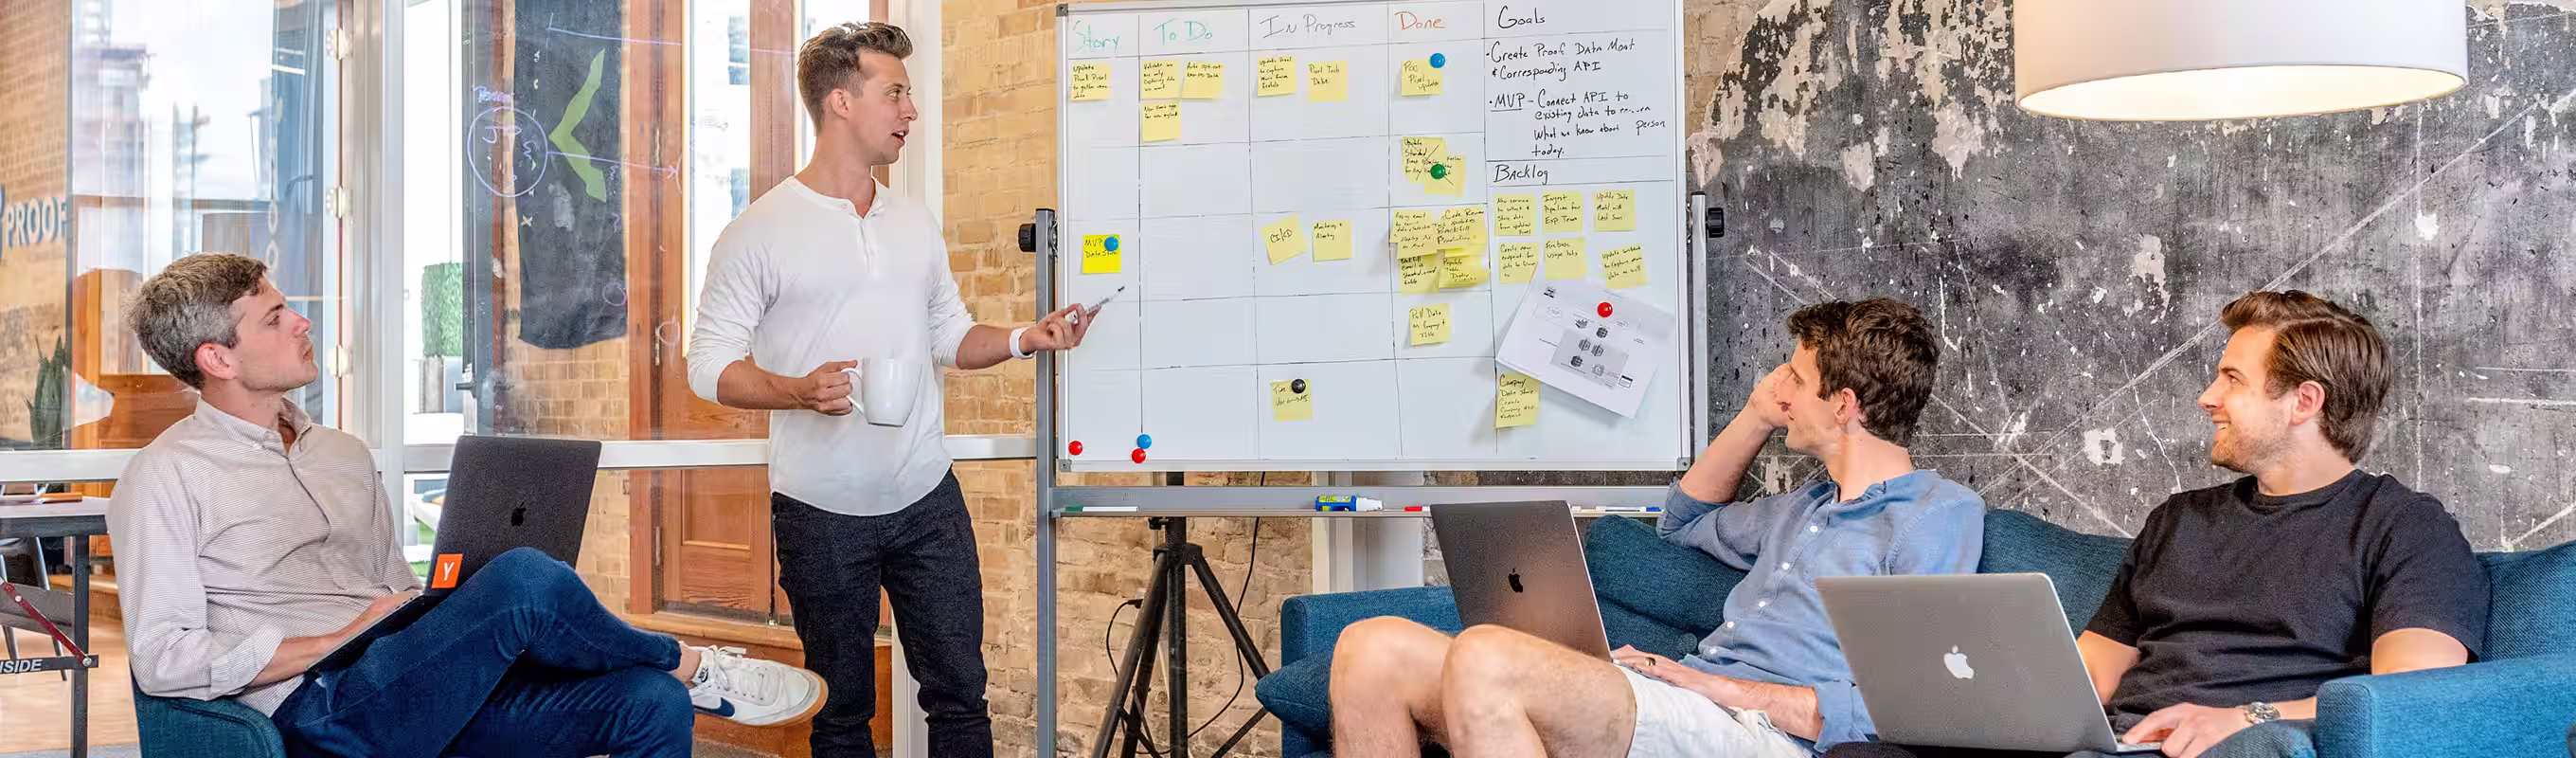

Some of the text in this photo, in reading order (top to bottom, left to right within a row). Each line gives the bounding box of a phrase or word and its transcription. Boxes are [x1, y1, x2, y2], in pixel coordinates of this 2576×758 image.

[1303, 14, 1356, 36] Progress
[1394, 10, 1446, 31] Done
[1497, 5, 1546, 29] Goals
[1073, 20, 1120, 52] Story
[1154, 18, 1213, 46] To Do
[1491, 41, 1529, 63] Create
[1534, 43, 1566, 58] Proof
[1575, 43, 1602, 56] Data
[1499, 62, 1567, 81] Corresponding
[1573, 62, 1602, 73] API
[1494, 93, 1526, 109] MVP
[1537, 89, 1577, 109] Connect
[1583, 92, 1608, 103] API
[1615, 90, 1629, 102] to
[1534, 106, 1572, 123] existing
[1577, 106, 1600, 119] data
[1605, 106, 1616, 116] to
[1576, 124, 1594, 137] know
[1635, 119, 1666, 136] person
[1494, 164, 1548, 185] Backlog
